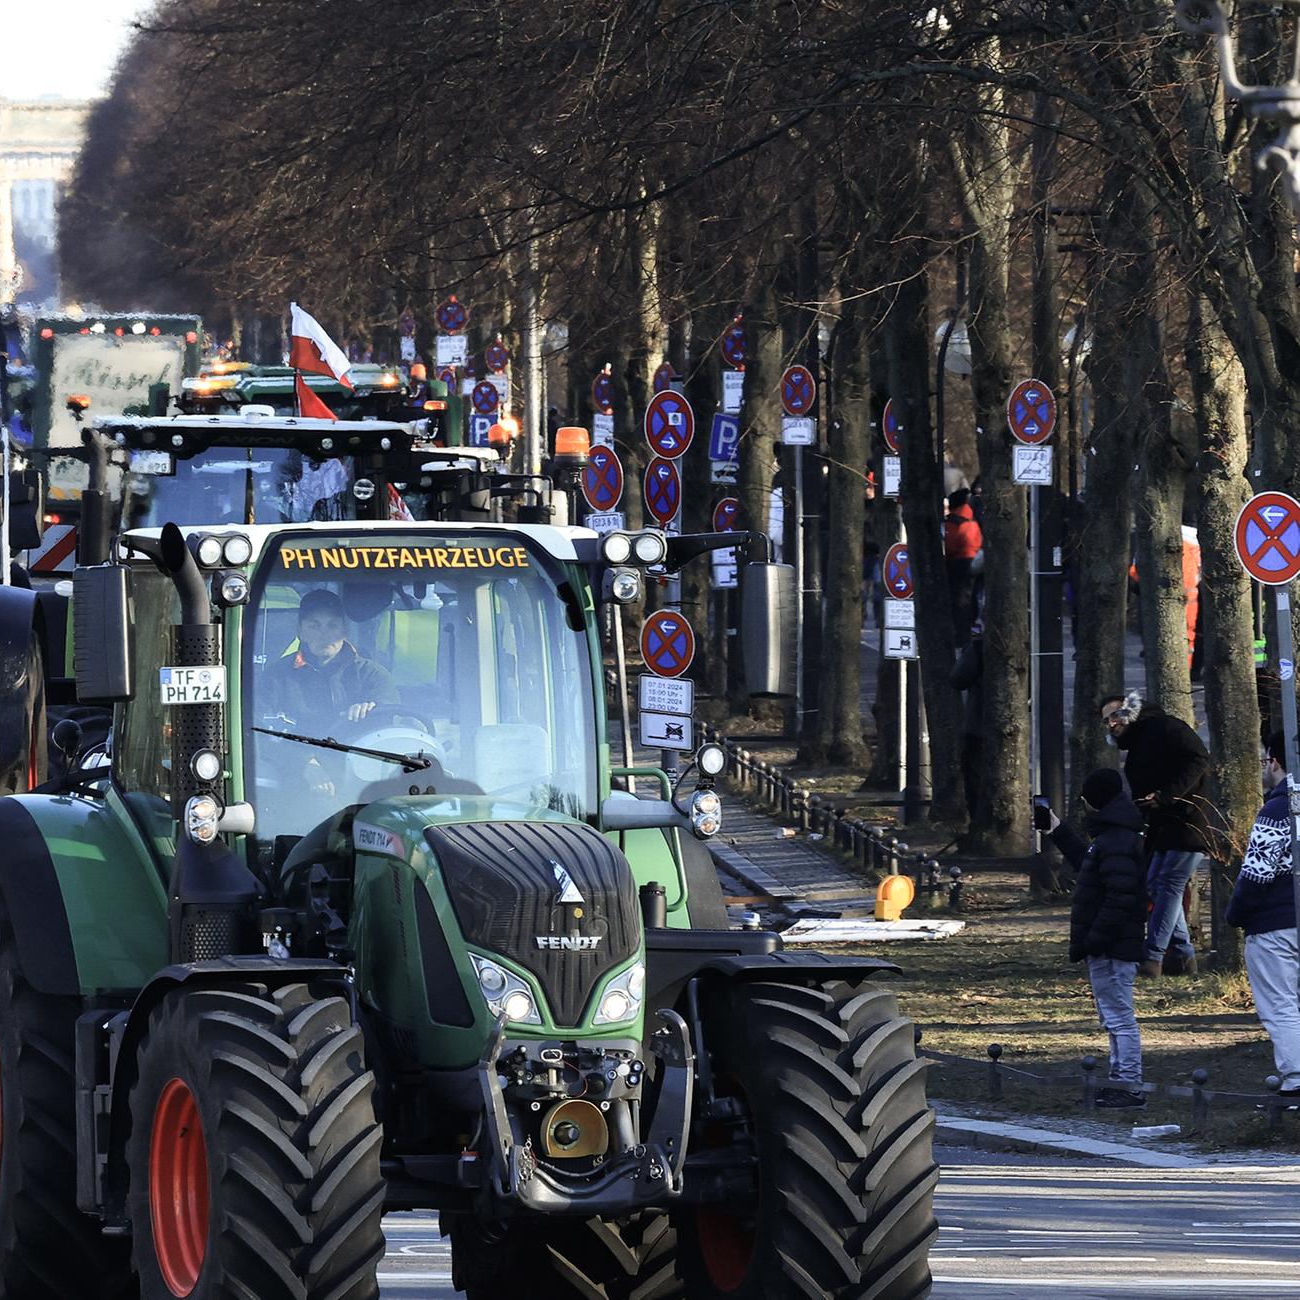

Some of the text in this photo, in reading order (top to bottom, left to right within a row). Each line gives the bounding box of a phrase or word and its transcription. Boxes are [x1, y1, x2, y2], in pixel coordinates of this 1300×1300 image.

[475, 418, 490, 444] P
[718, 421, 737, 454] P
[280, 548, 529, 568] PH NUTZFAHRZEUGE
[175, 670, 195, 684] TF
[167, 685, 221, 701] PH 714
[536, 936, 602, 950] FENDT
